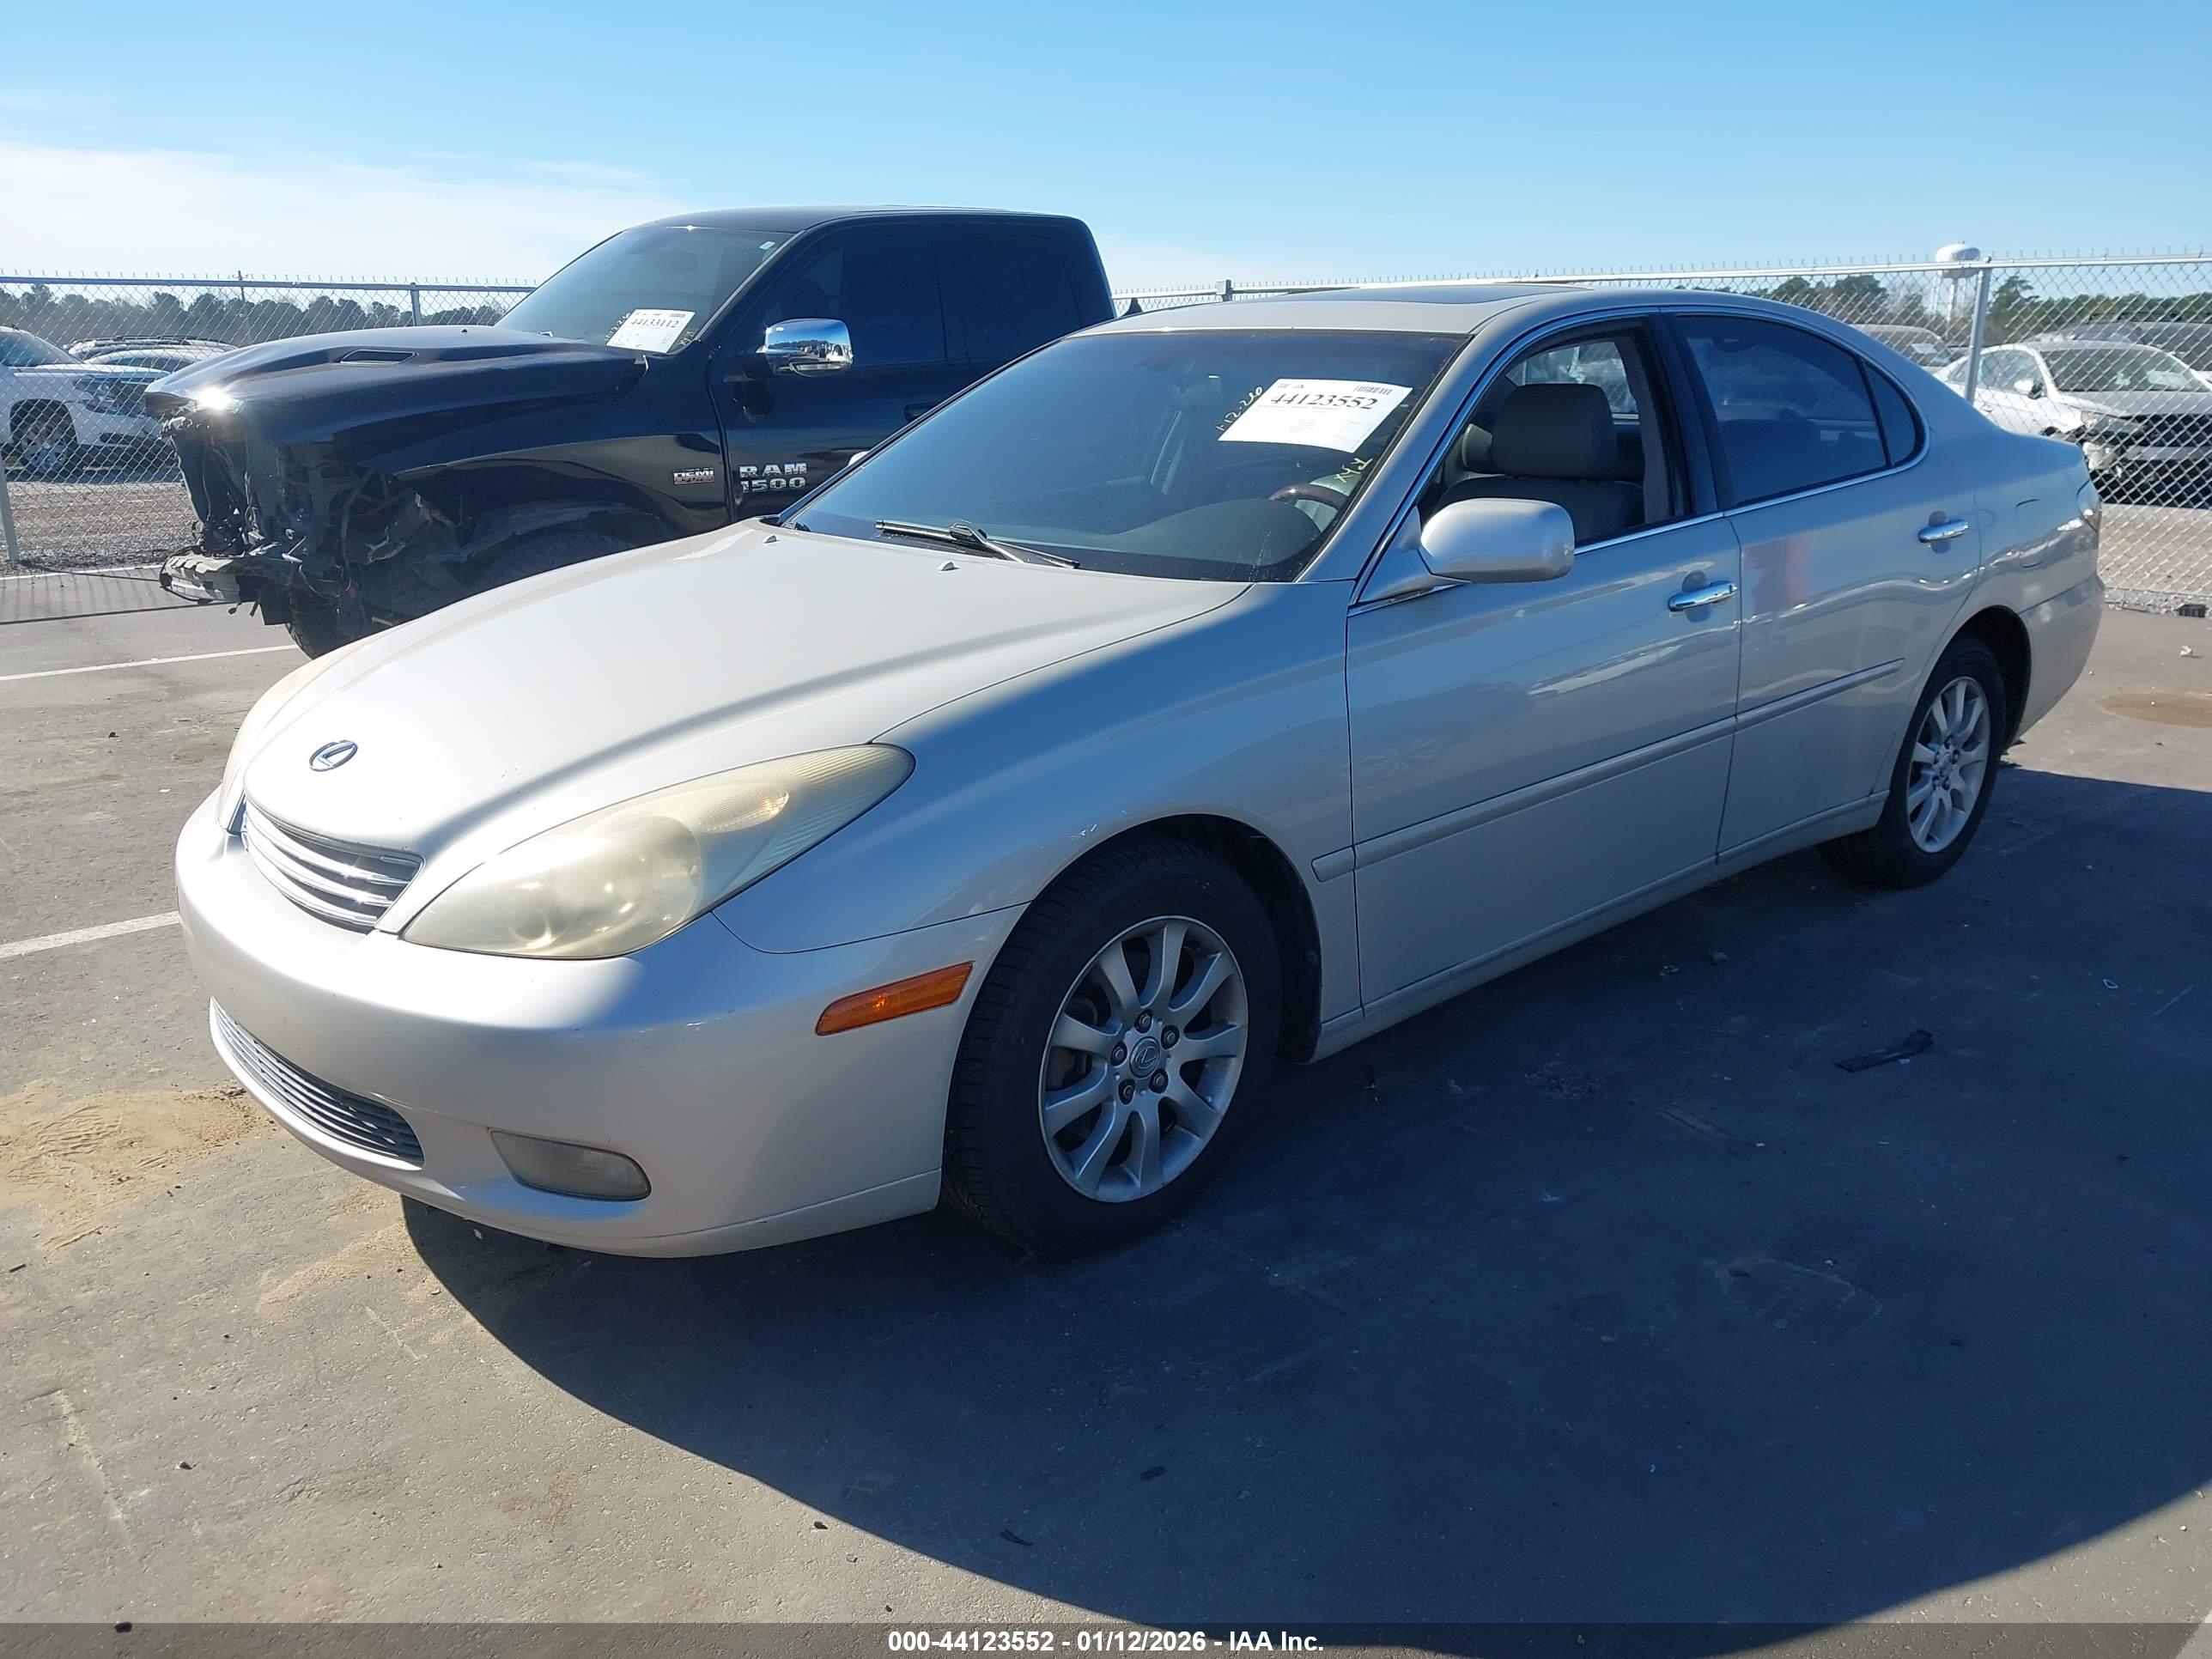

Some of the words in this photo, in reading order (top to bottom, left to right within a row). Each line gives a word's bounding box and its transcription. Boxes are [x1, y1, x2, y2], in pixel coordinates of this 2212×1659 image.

[630, 319, 679, 329] 44133112
[1271, 393, 1378, 410] 44123552
[739, 462, 807, 478] RAM
[740, 477, 806, 493] 1500
